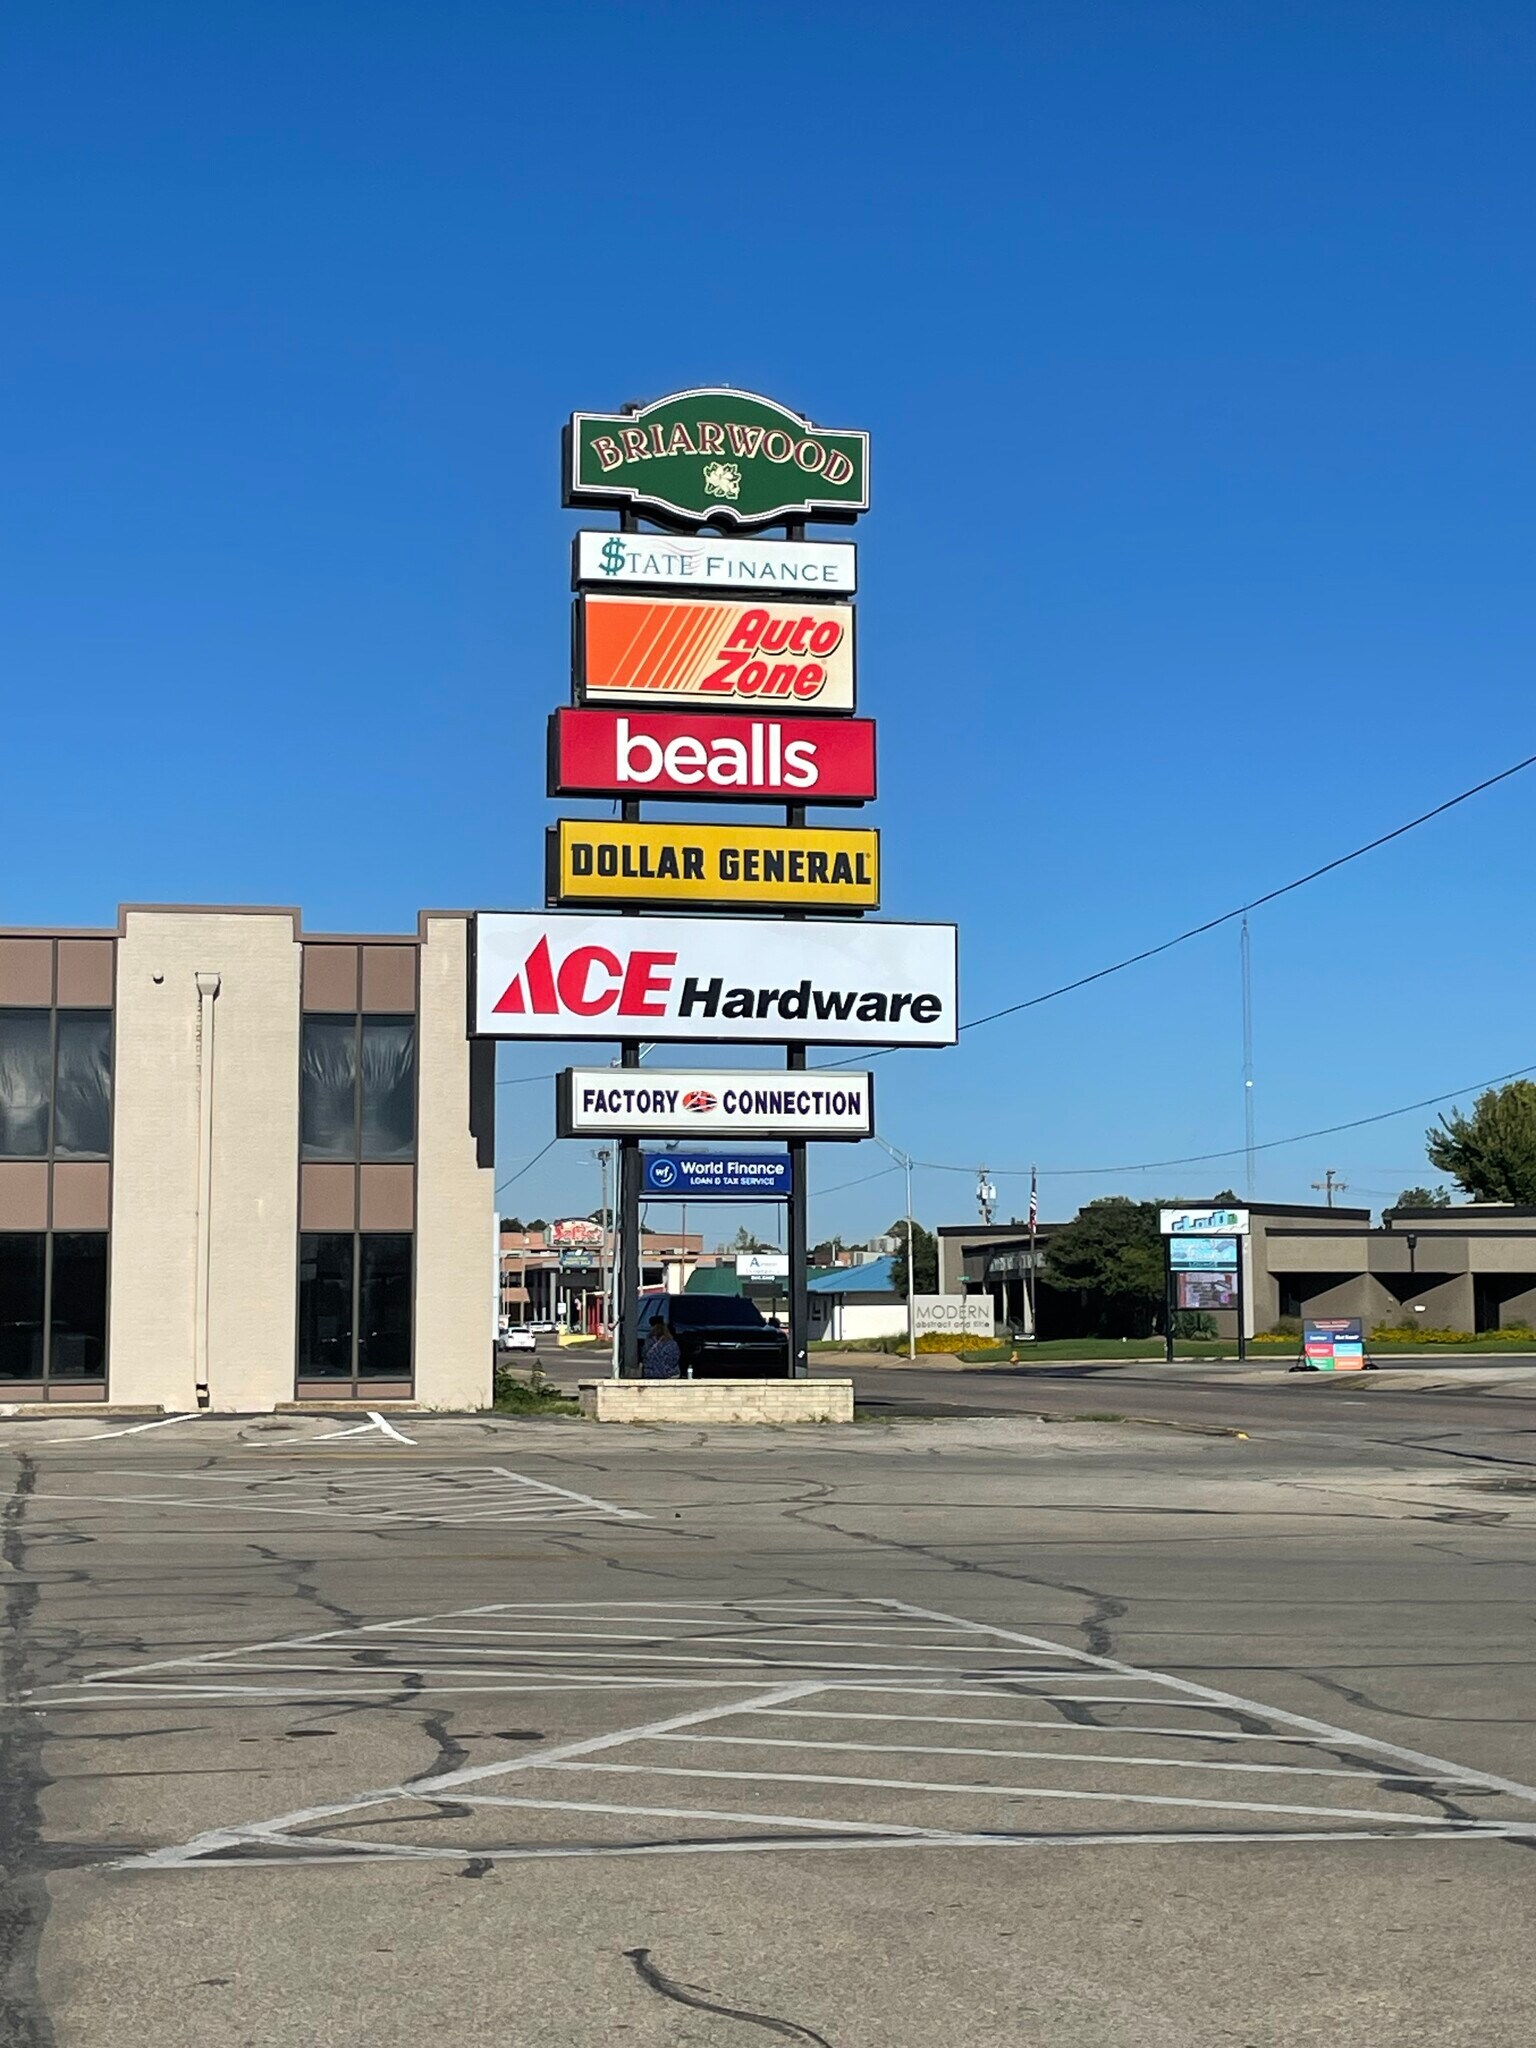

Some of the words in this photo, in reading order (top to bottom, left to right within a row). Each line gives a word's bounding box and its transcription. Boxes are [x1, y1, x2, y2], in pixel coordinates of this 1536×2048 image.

[589, 421, 854, 485] BRIARWOOD
[705, 556, 840, 583] FINANCE
[723, 608, 844, 657] Auto
[698, 650, 827, 700] Zone
[616, 718, 819, 788] bealls
[570, 843, 706, 880] DOLLAR
[718, 847, 872, 885] GENERAL
[491, 933, 678, 1018] ACE
[678, 977, 943, 1024] Hardware
[583, 1088, 680, 1114] FACTORY
[722, 1089, 862, 1116] CONNECTION
[680, 1161, 724, 1175] World
[727, 1161, 785, 1175] Finance
[690, 1176, 714, 1186] LOAN
[723, 1176, 739, 1186] TAX
[740, 1176, 775, 1186] SERVICE
[916, 1304, 990, 1320] MODERN
